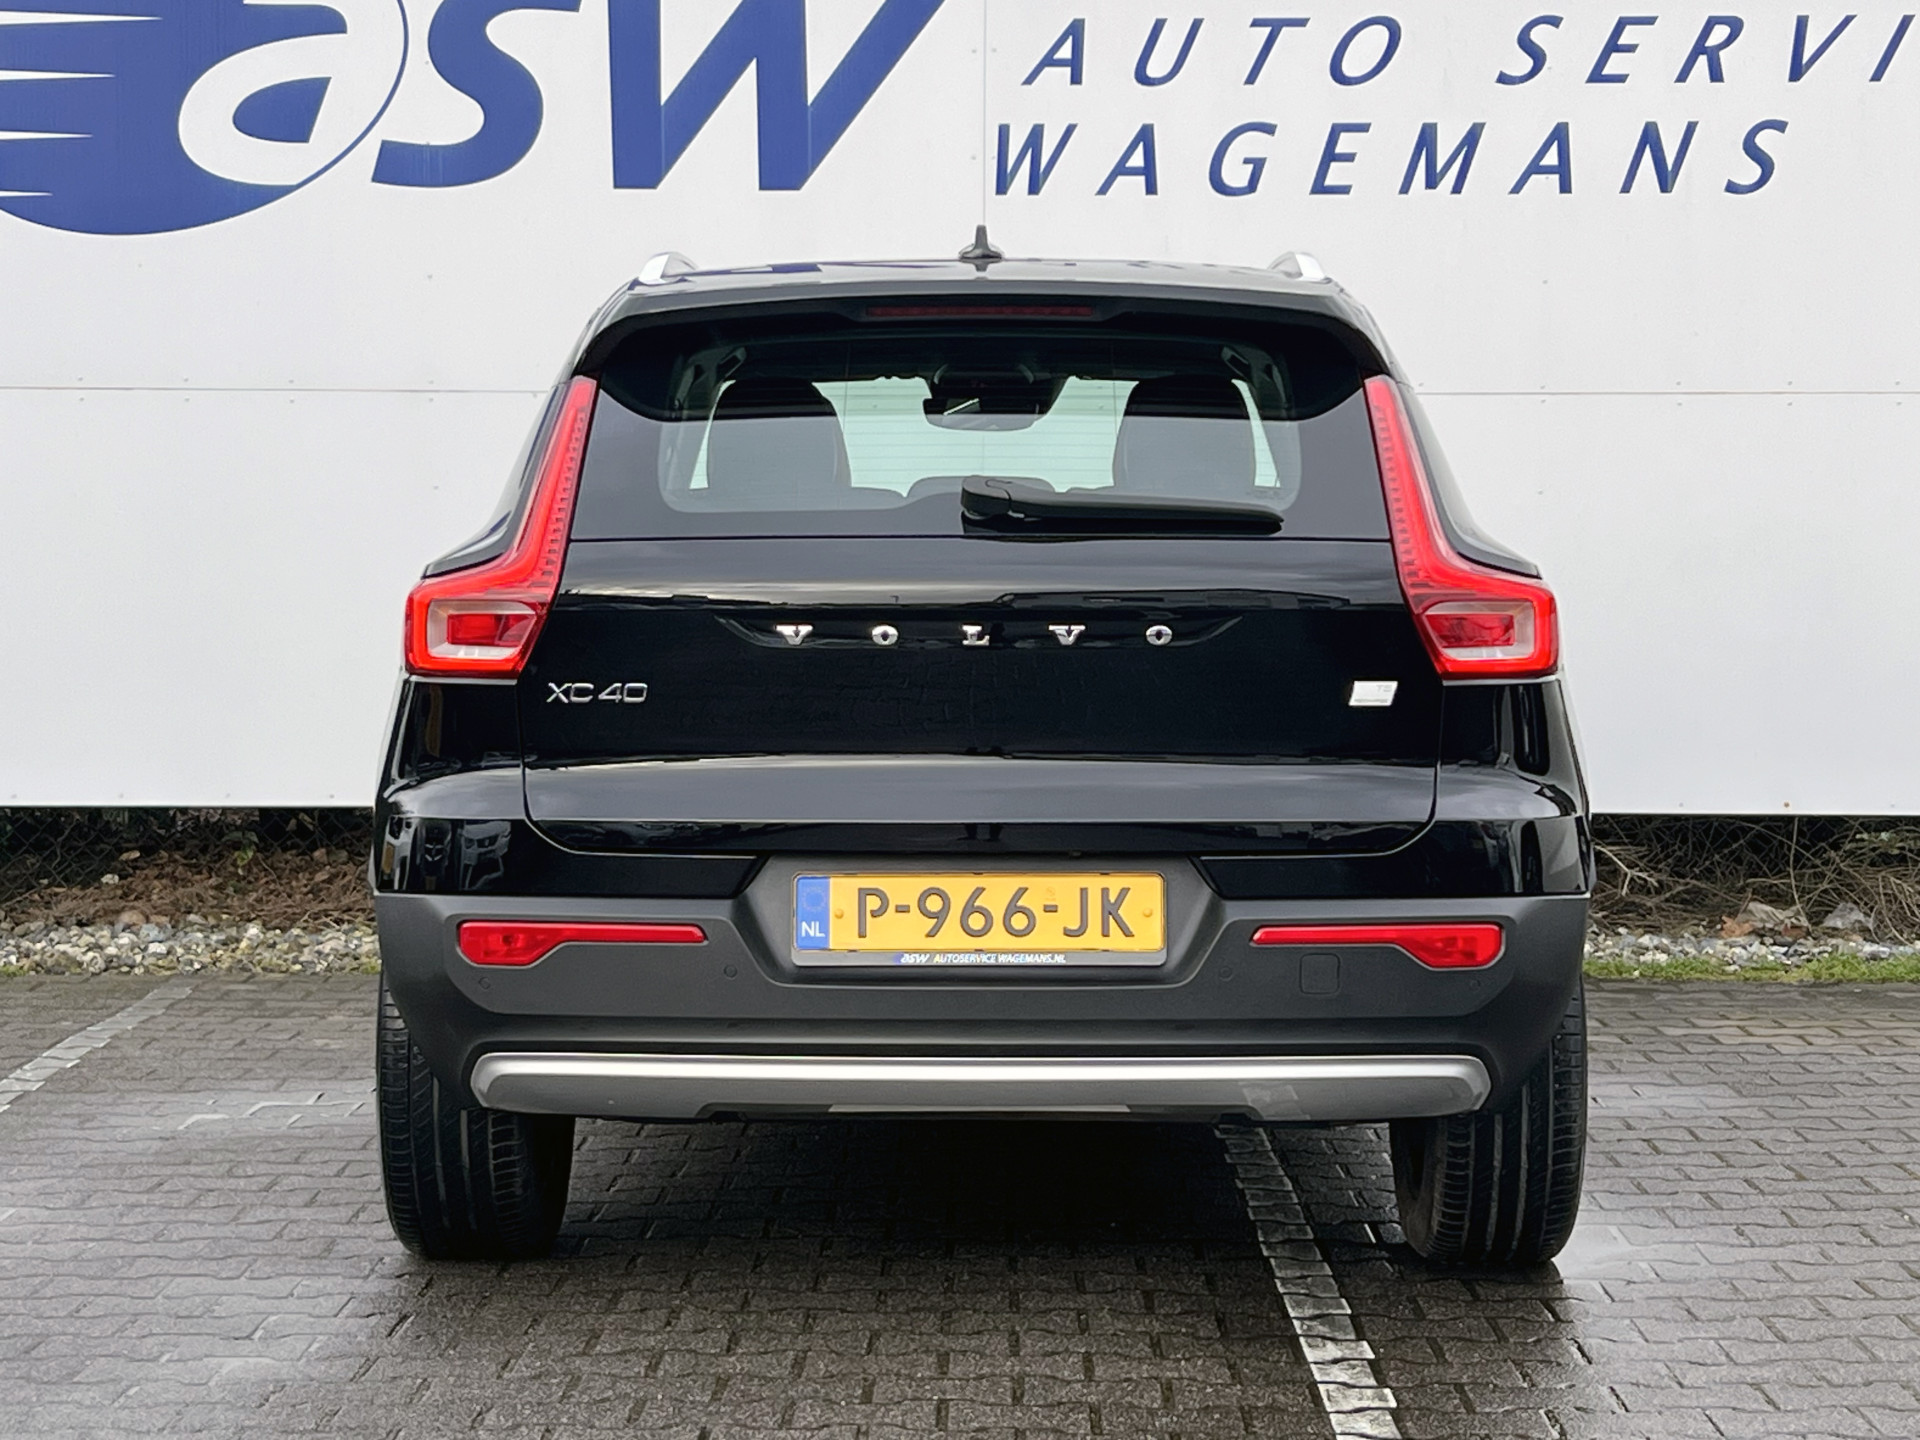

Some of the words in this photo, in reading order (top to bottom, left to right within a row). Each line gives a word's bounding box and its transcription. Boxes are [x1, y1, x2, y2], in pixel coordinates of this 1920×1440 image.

[1022, 16, 1402, 87] AUTO
[1496, 14, 1916, 86] SERVI
[996, 119, 1789, 196] WAGEMANS
[774, 624, 1173, 646] VOLVO
[546, 682, 648, 703] XC40
[858, 886, 1136, 939] P-966-JK
[801, 921, 826, 938] NL
[933, 953, 996, 964] AUTOSERVICE
[998, 953, 1066, 964] WAGEMANS.NL
